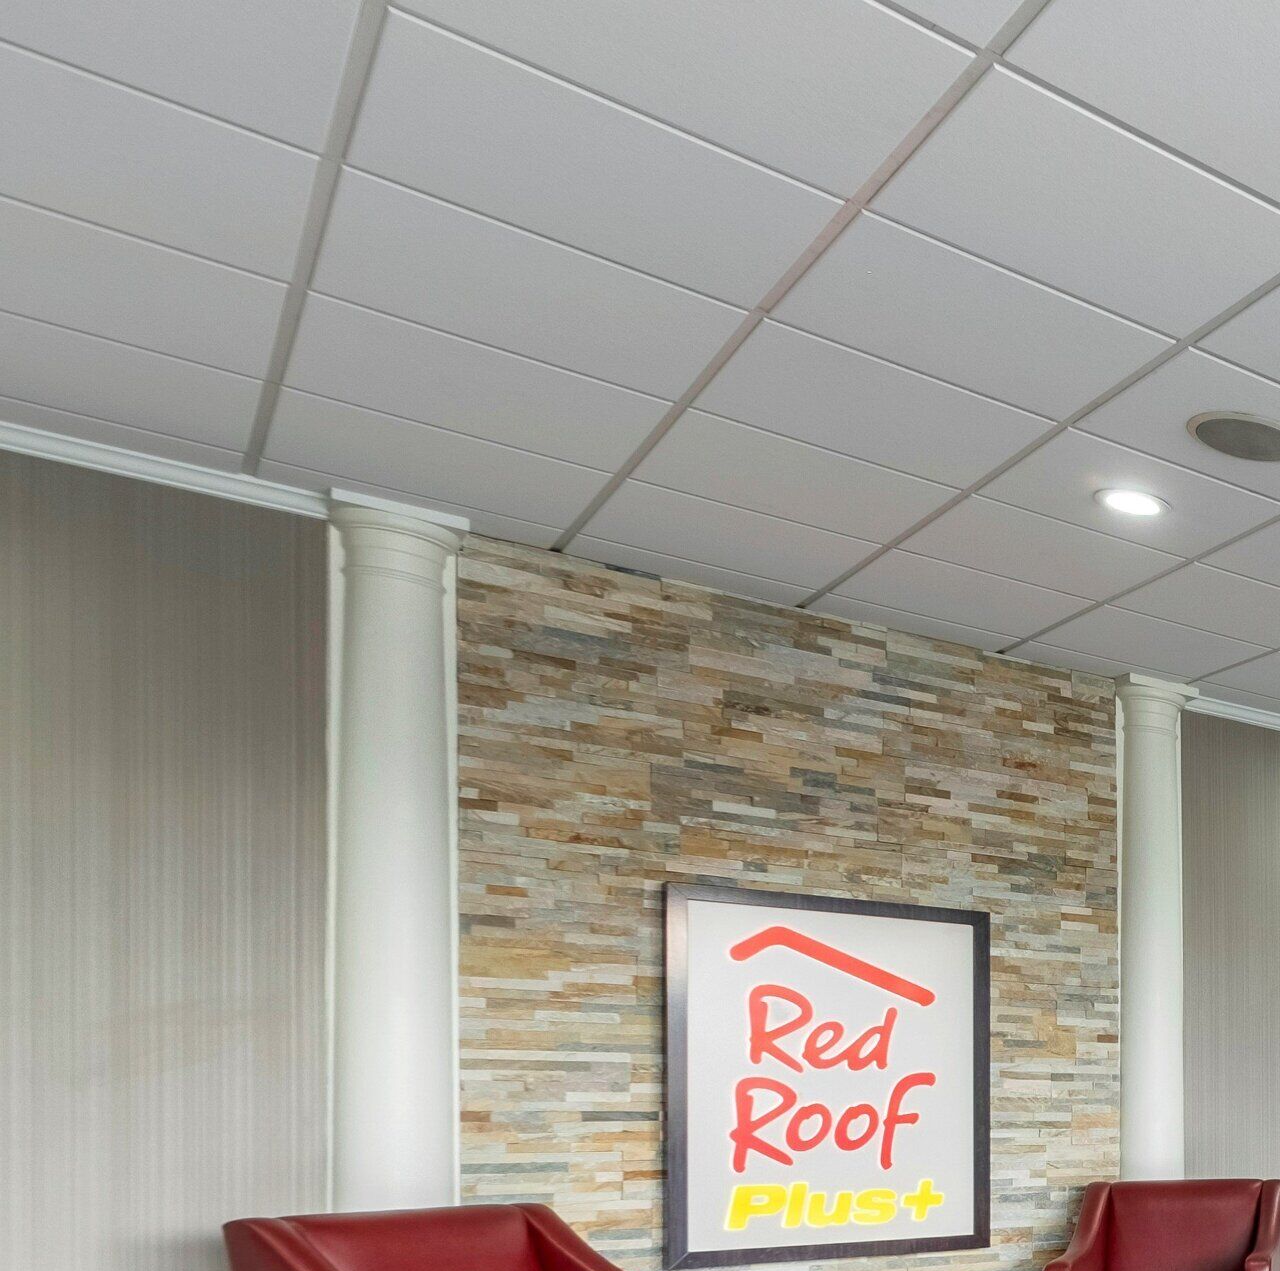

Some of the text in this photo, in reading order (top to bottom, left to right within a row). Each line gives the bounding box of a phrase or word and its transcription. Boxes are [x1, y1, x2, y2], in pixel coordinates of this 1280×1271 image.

[748, 984, 898, 1073] Red
[729, 1072, 937, 1173] Roof
[724, 1178, 944, 1231] Plus+
